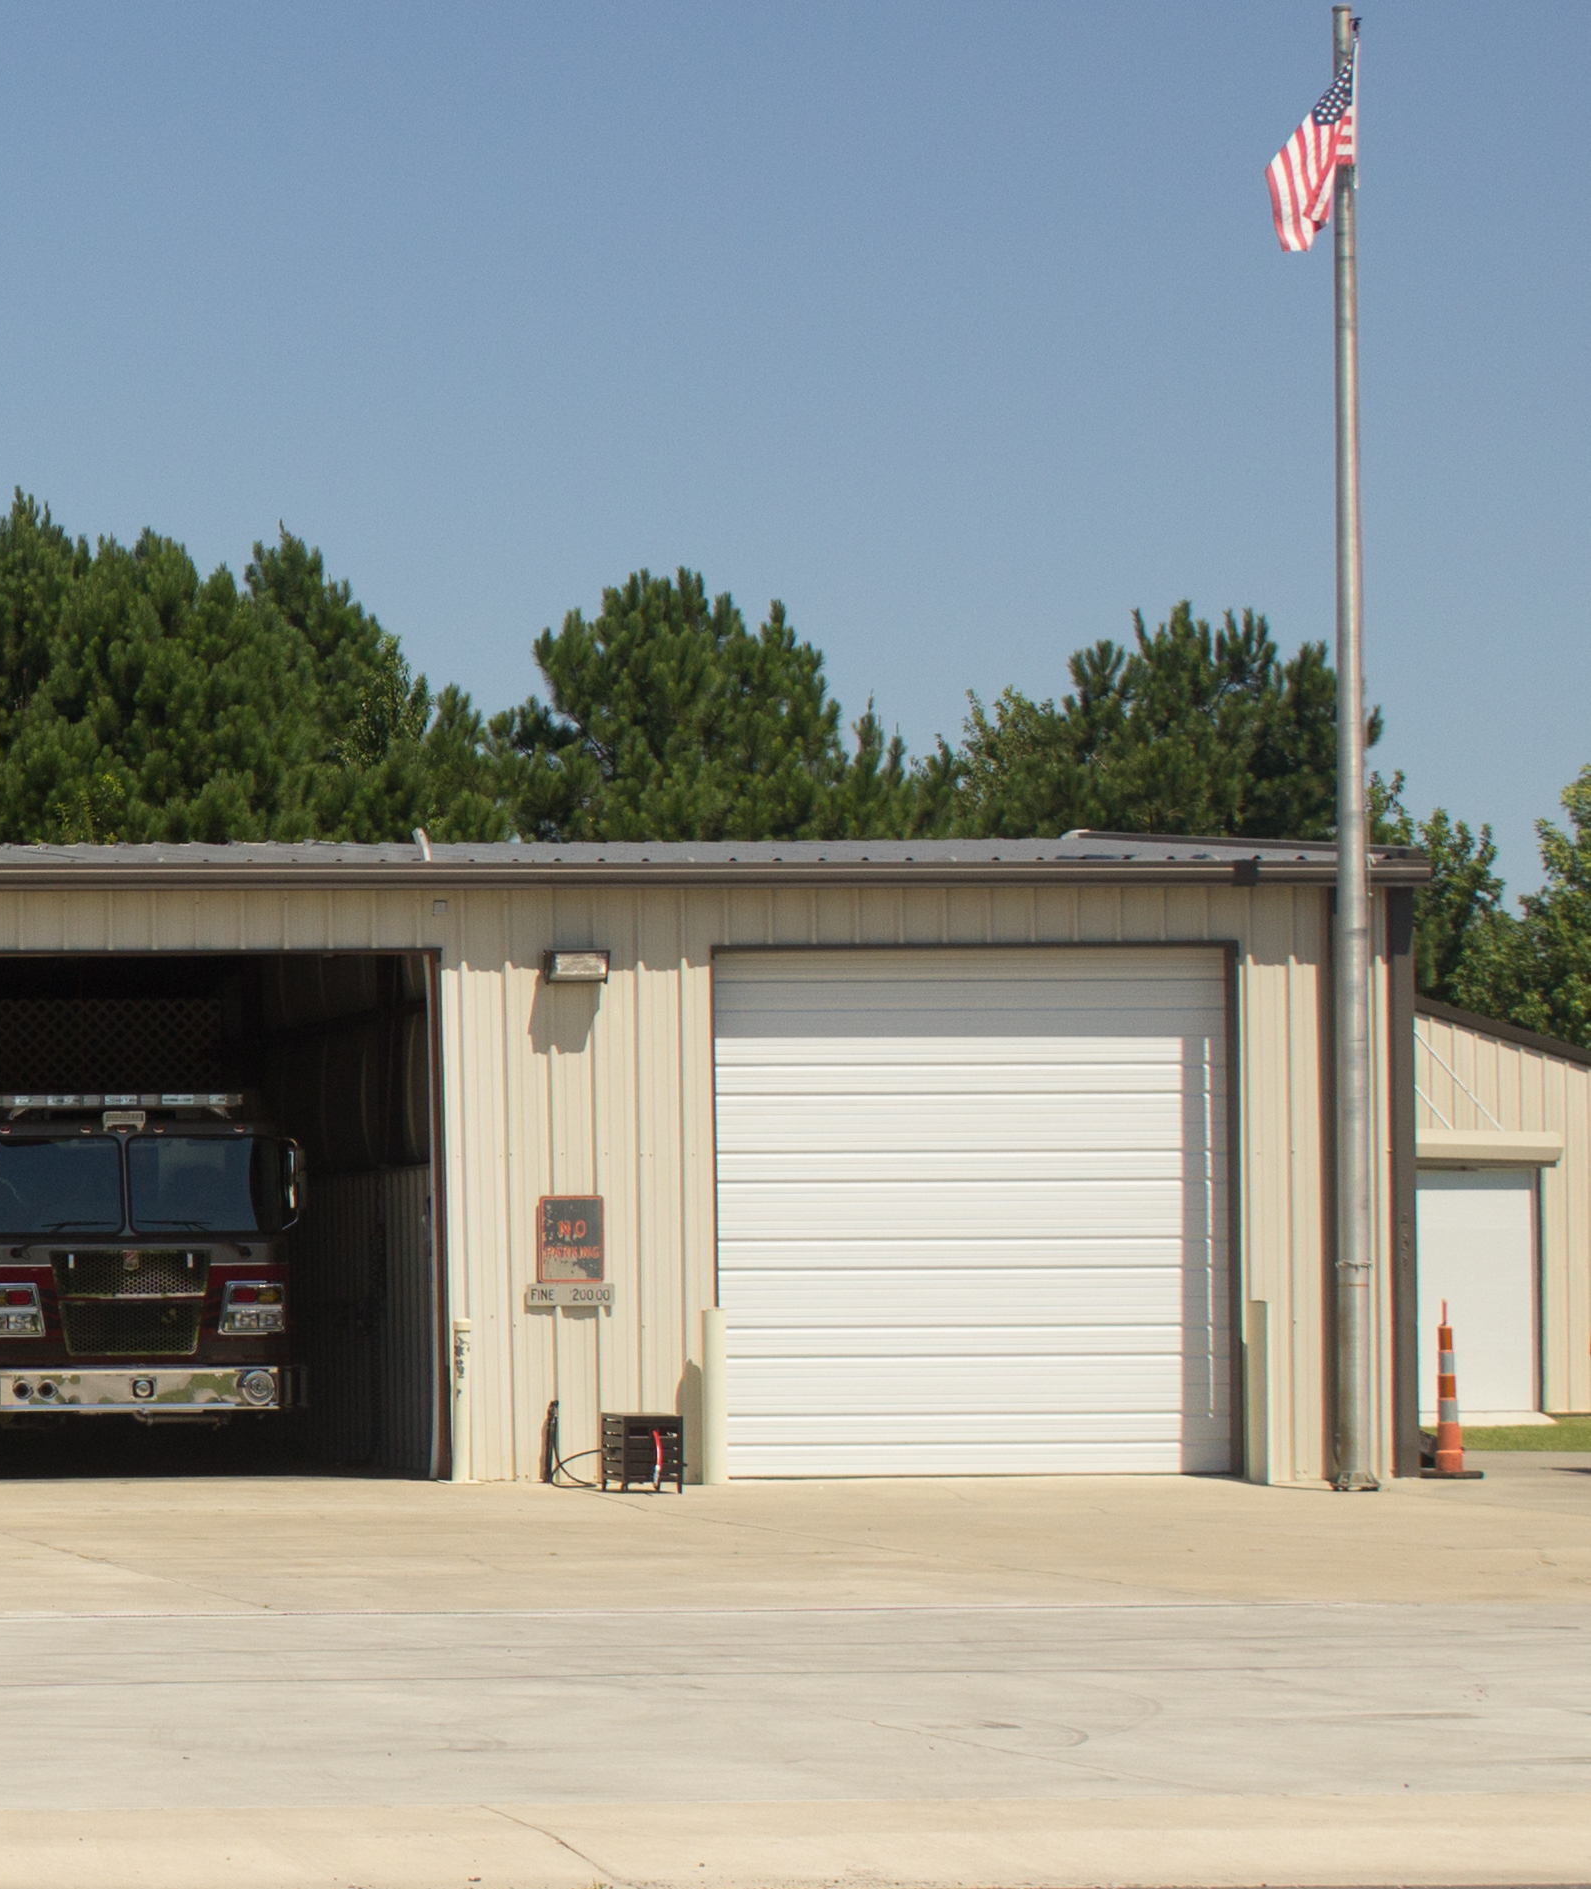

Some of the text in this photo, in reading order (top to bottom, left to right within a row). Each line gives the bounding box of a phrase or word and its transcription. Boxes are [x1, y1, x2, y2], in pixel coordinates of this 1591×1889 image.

[557, 1219, 587, 1237] NO
[545, 1246, 600, 1258] PARKING
[530, 1288, 555, 1301] FINE
